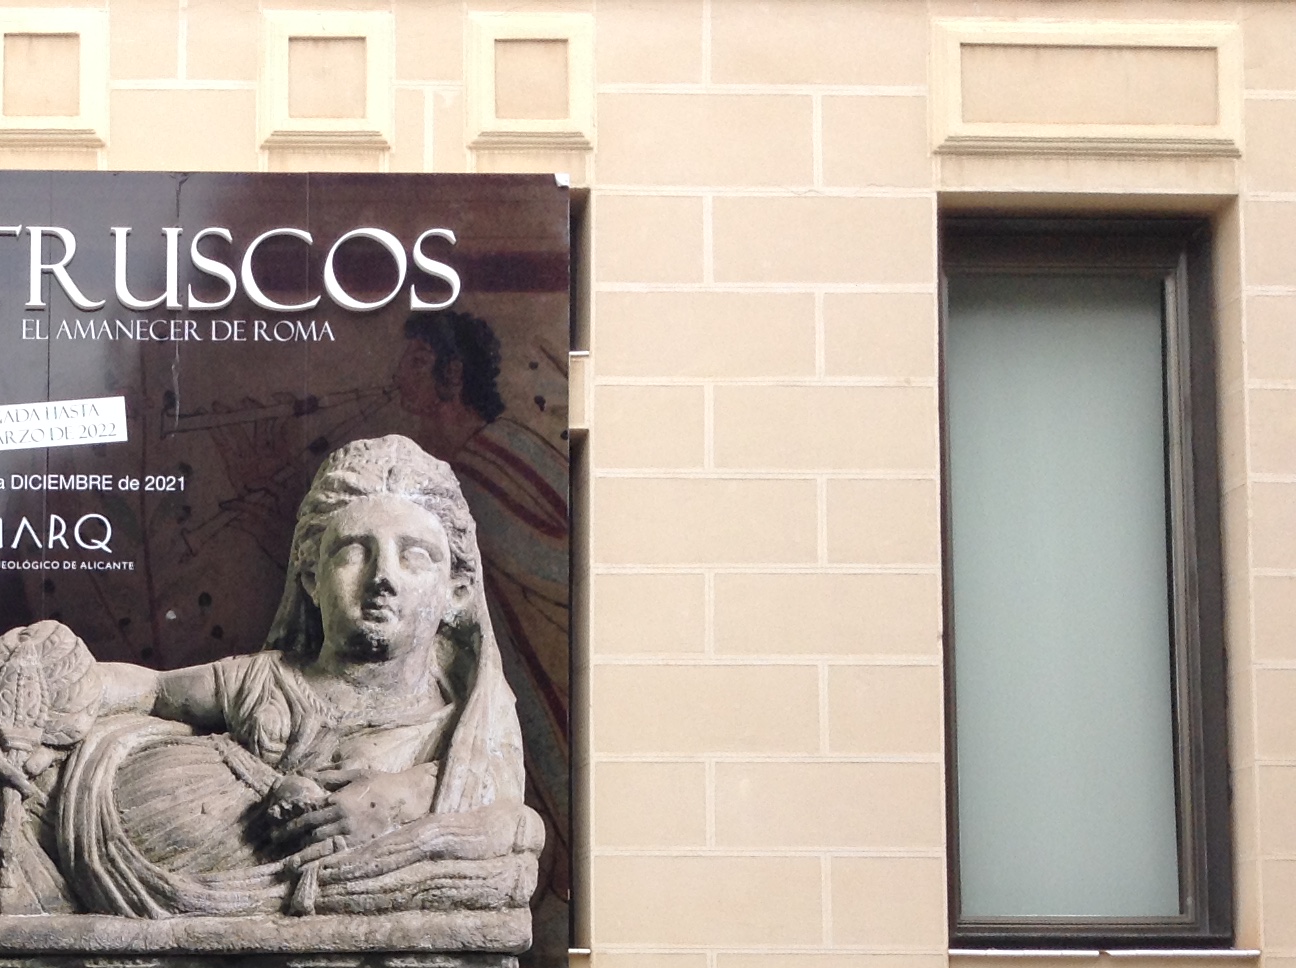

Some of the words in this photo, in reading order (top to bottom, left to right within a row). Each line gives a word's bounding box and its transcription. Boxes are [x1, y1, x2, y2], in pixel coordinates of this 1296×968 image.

[21, 318, 49, 340] EL
[56, 319, 201, 342] AMANECER
[211, 320, 247, 342] DE
[253, 321, 335, 342] ROMA
[45, 403, 100, 421] HASTA
[49, 426, 74, 442] DE
[79, 422, 117, 440] 2022
[11, 475, 113, 491] DICIEMBRE
[118, 475, 140, 491] de
[145, 475, 185, 491] 2021
[63, 561, 77, 570] DE
[80, 561, 134, 571] ALICANTE
